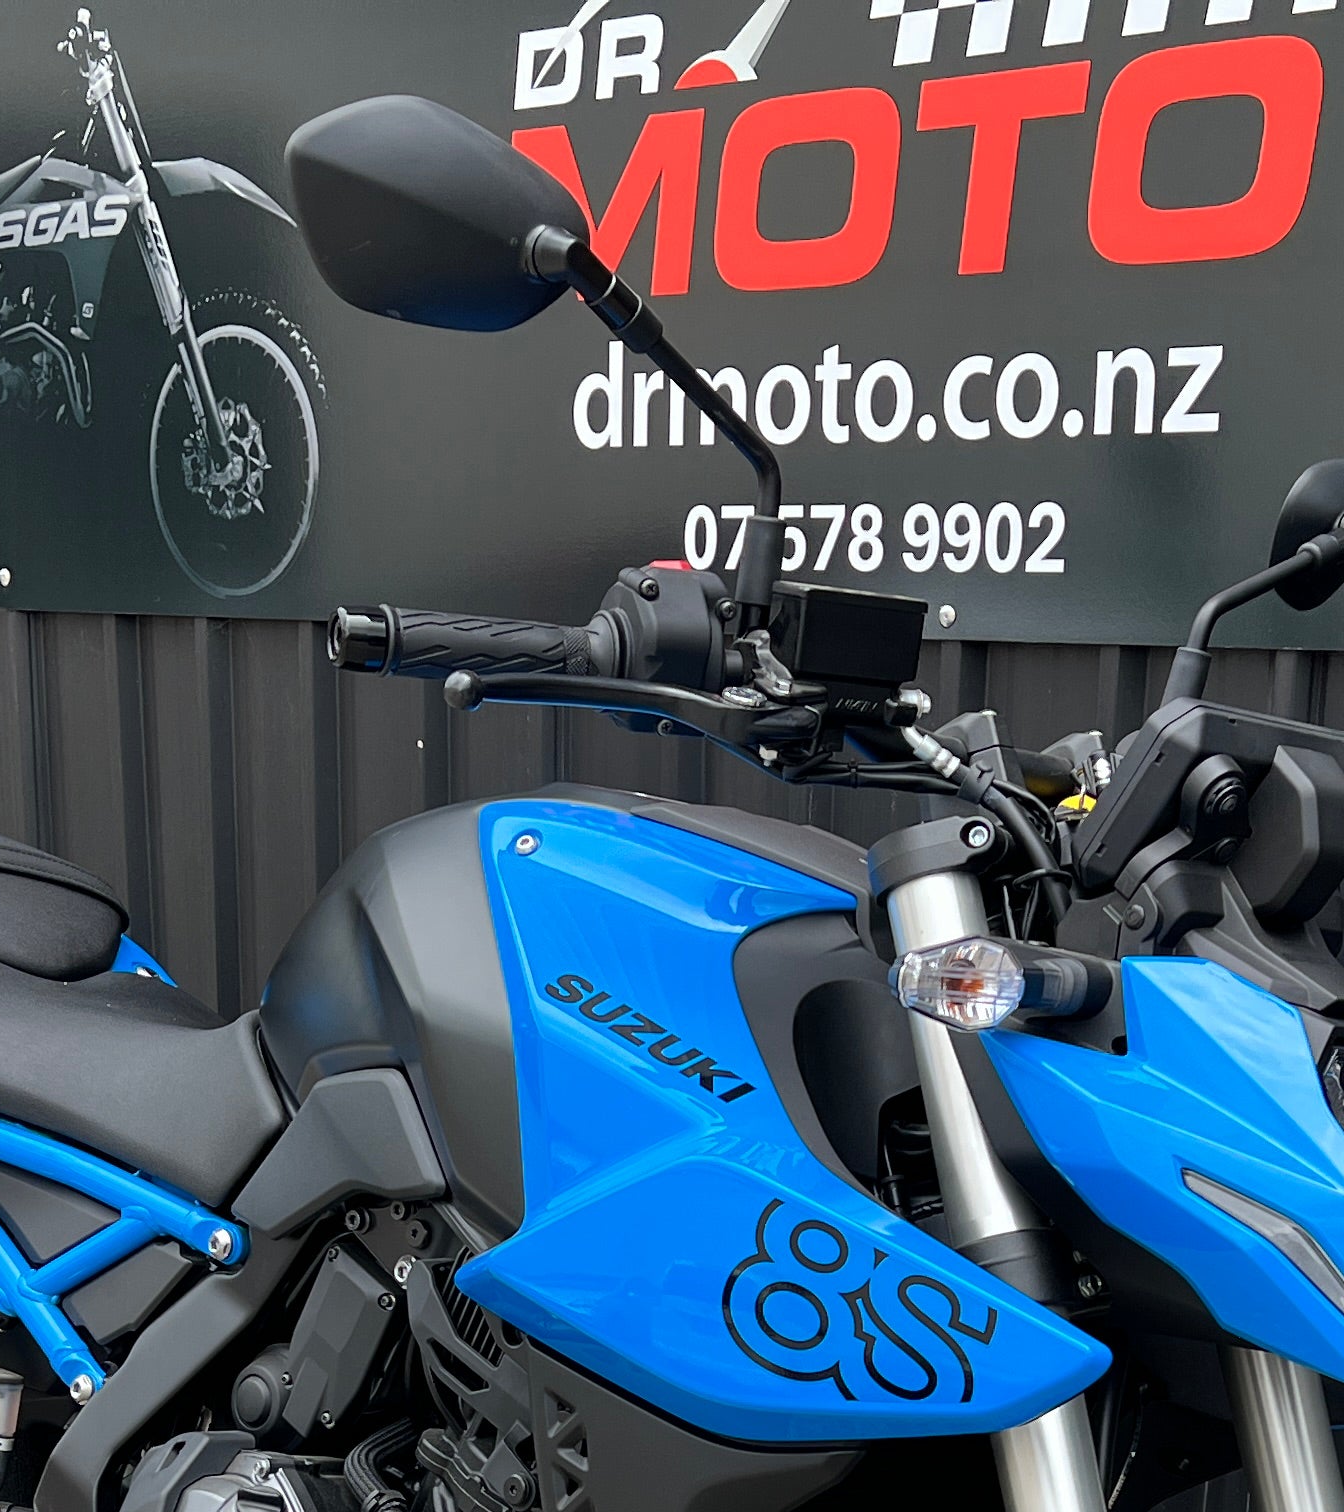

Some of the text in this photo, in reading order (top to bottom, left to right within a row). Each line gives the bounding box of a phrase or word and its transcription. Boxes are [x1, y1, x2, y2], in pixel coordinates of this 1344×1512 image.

[513, 14, 664, 110] DR
[511, 34, 1324, 302] MOTO
[572, 340, 1224, 450] drmoto.co.nz
[683, 500, 1067, 574] 07 578 9902
[544, 973, 757, 1103] SUZUKI
